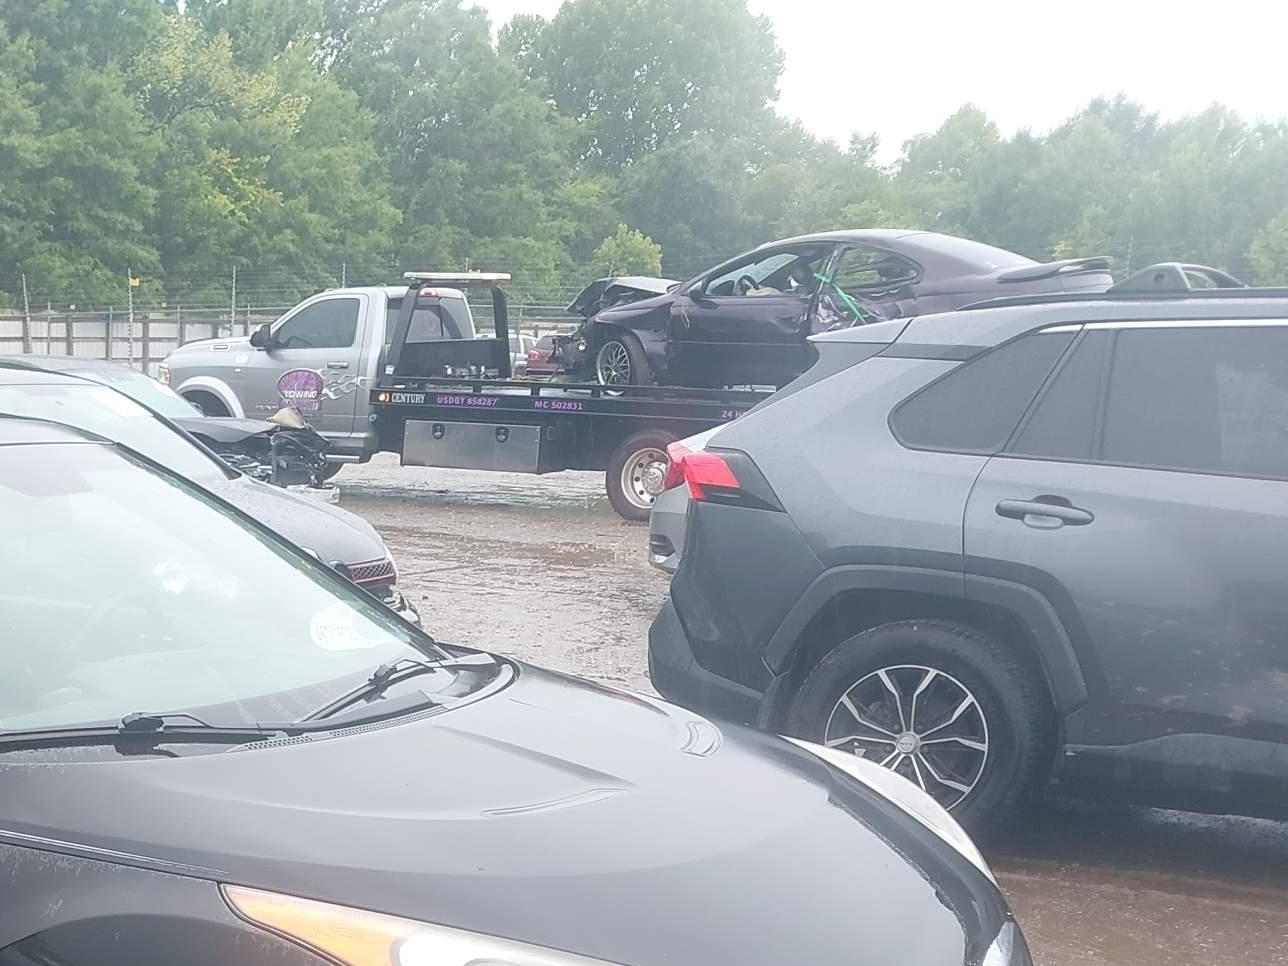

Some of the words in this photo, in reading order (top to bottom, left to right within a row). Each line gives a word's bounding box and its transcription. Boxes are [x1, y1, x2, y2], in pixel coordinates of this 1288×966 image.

[283, 390, 318, 399] TOWING
[391, 392, 425, 404] CENTURY
[534, 400, 549, 409] MC
[551, 401, 583, 410] 502831
[721, 409, 732, 418] 24
